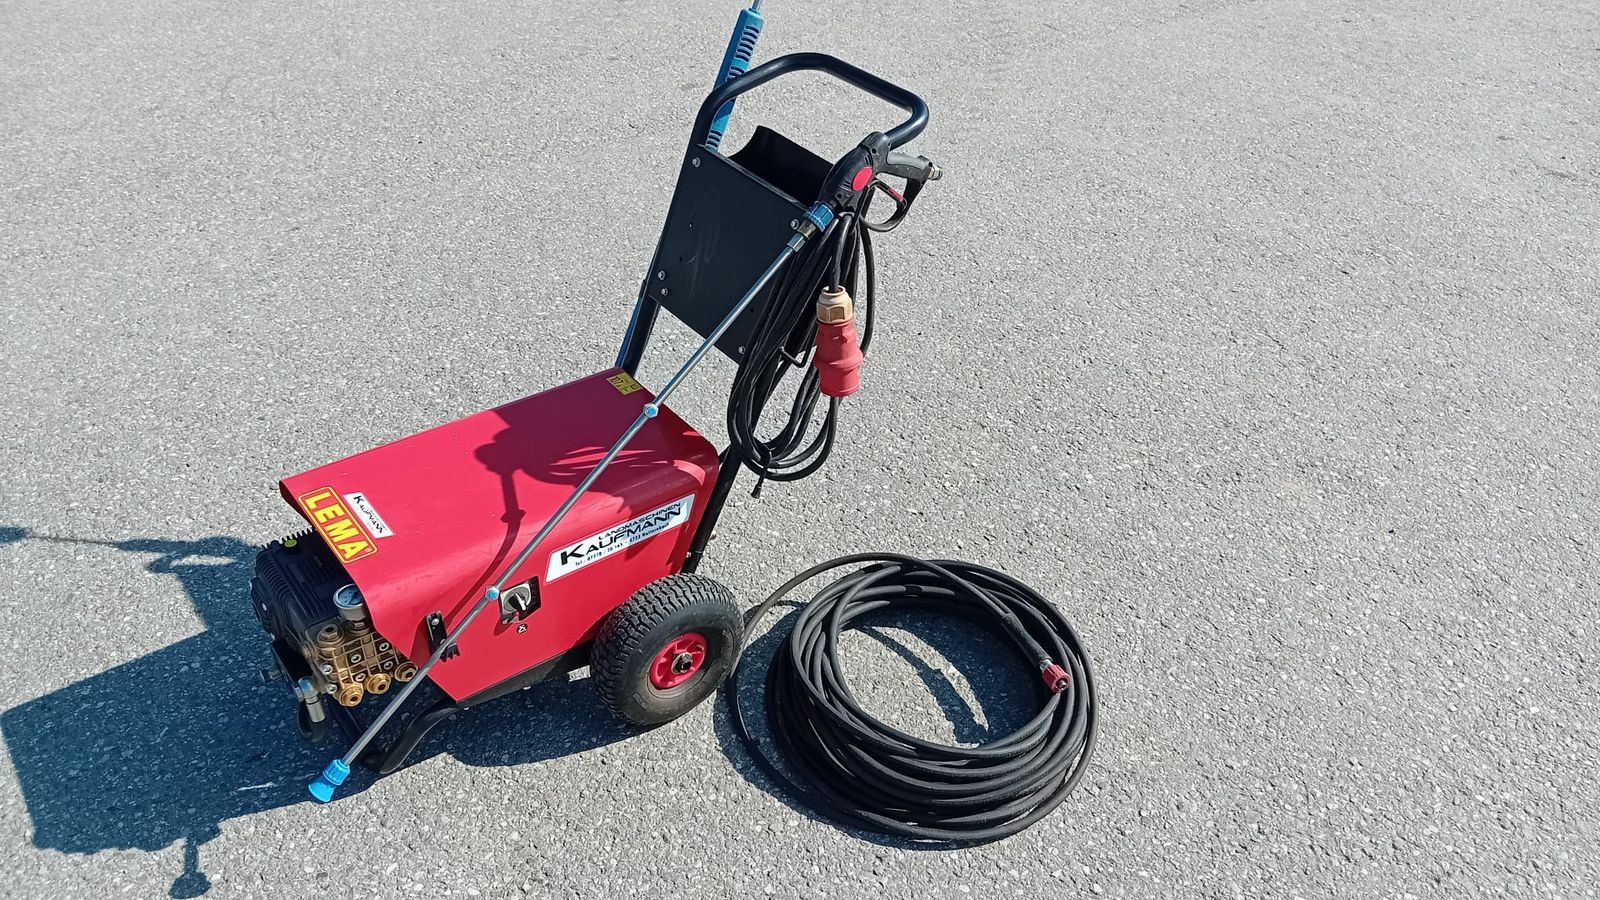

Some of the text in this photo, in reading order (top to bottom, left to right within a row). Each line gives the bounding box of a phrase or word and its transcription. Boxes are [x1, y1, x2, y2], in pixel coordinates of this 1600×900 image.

[304, 491, 369, 559] LEMA
[560, 507, 681, 566] KAUFMANN
[598, 503, 681, 540] LANDMASCHINEN
